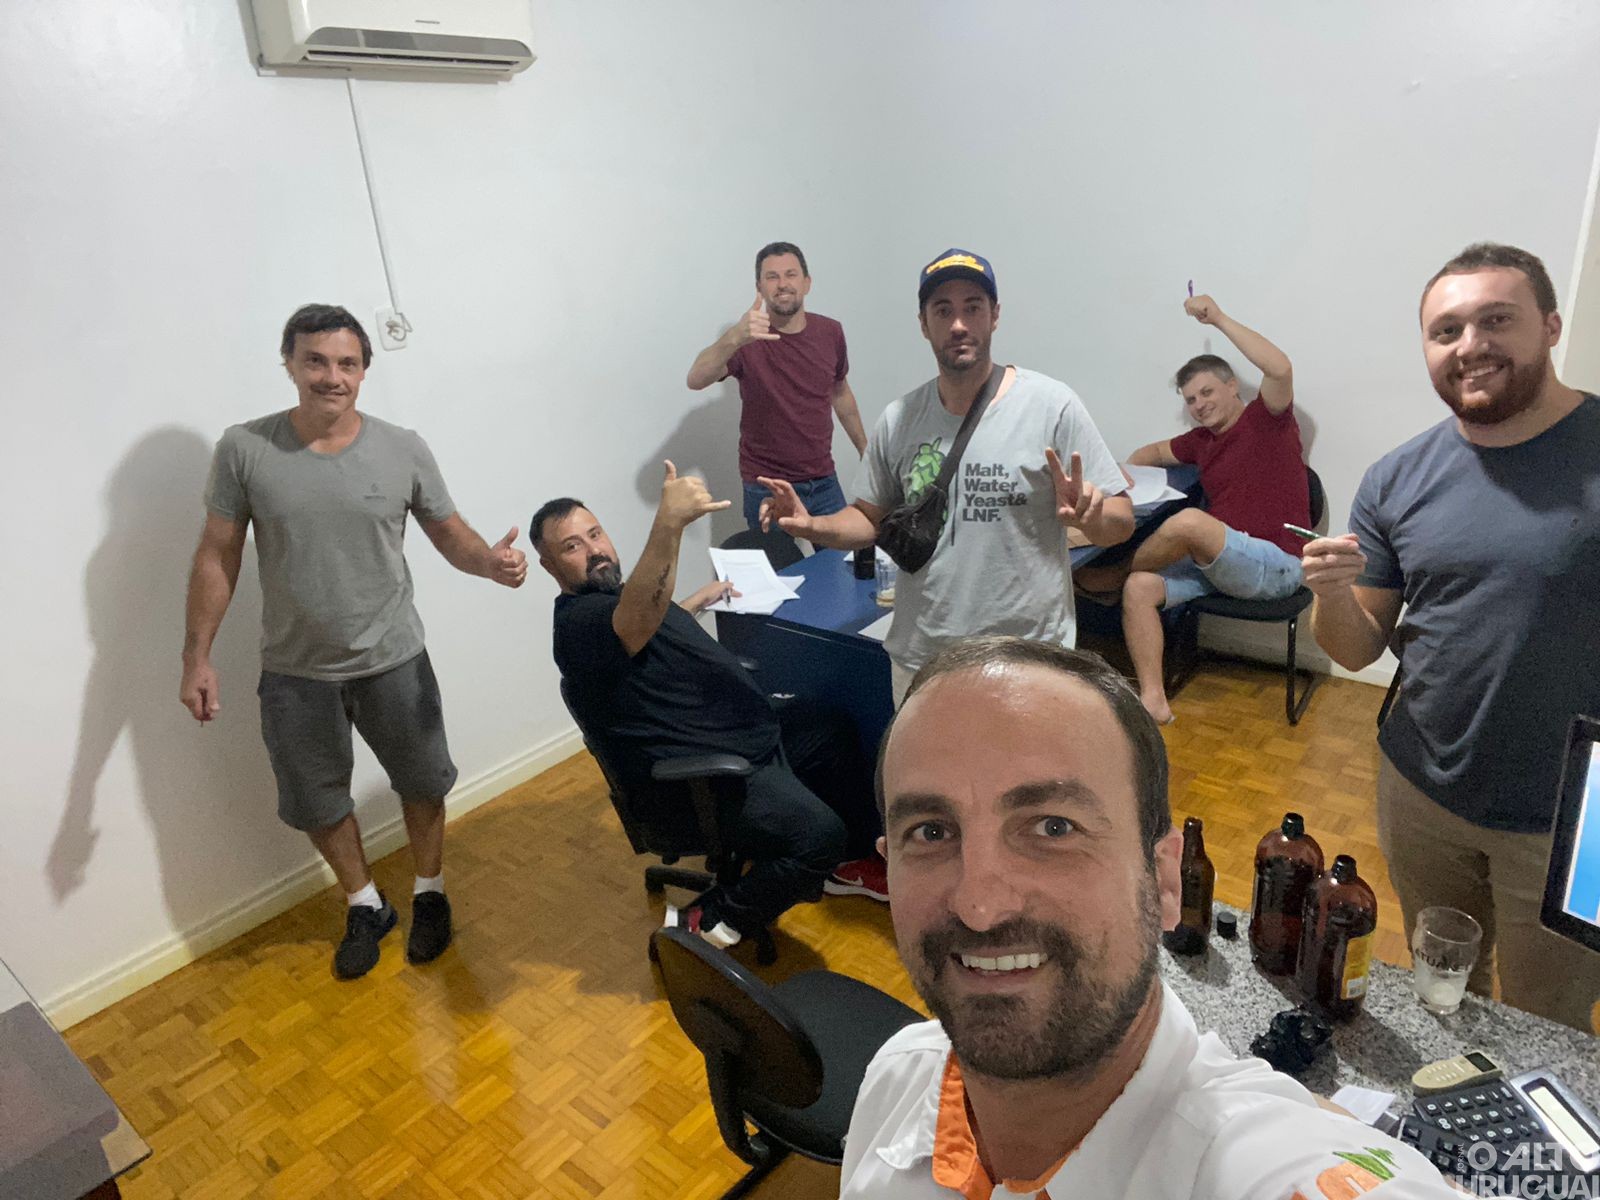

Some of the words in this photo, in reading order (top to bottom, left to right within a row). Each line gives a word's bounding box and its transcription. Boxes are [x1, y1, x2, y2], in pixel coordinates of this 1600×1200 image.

[965, 463, 1009, 479] Malt,
[964, 478, 1018, 493] Water
[962, 508, 1002, 522] LNF.
